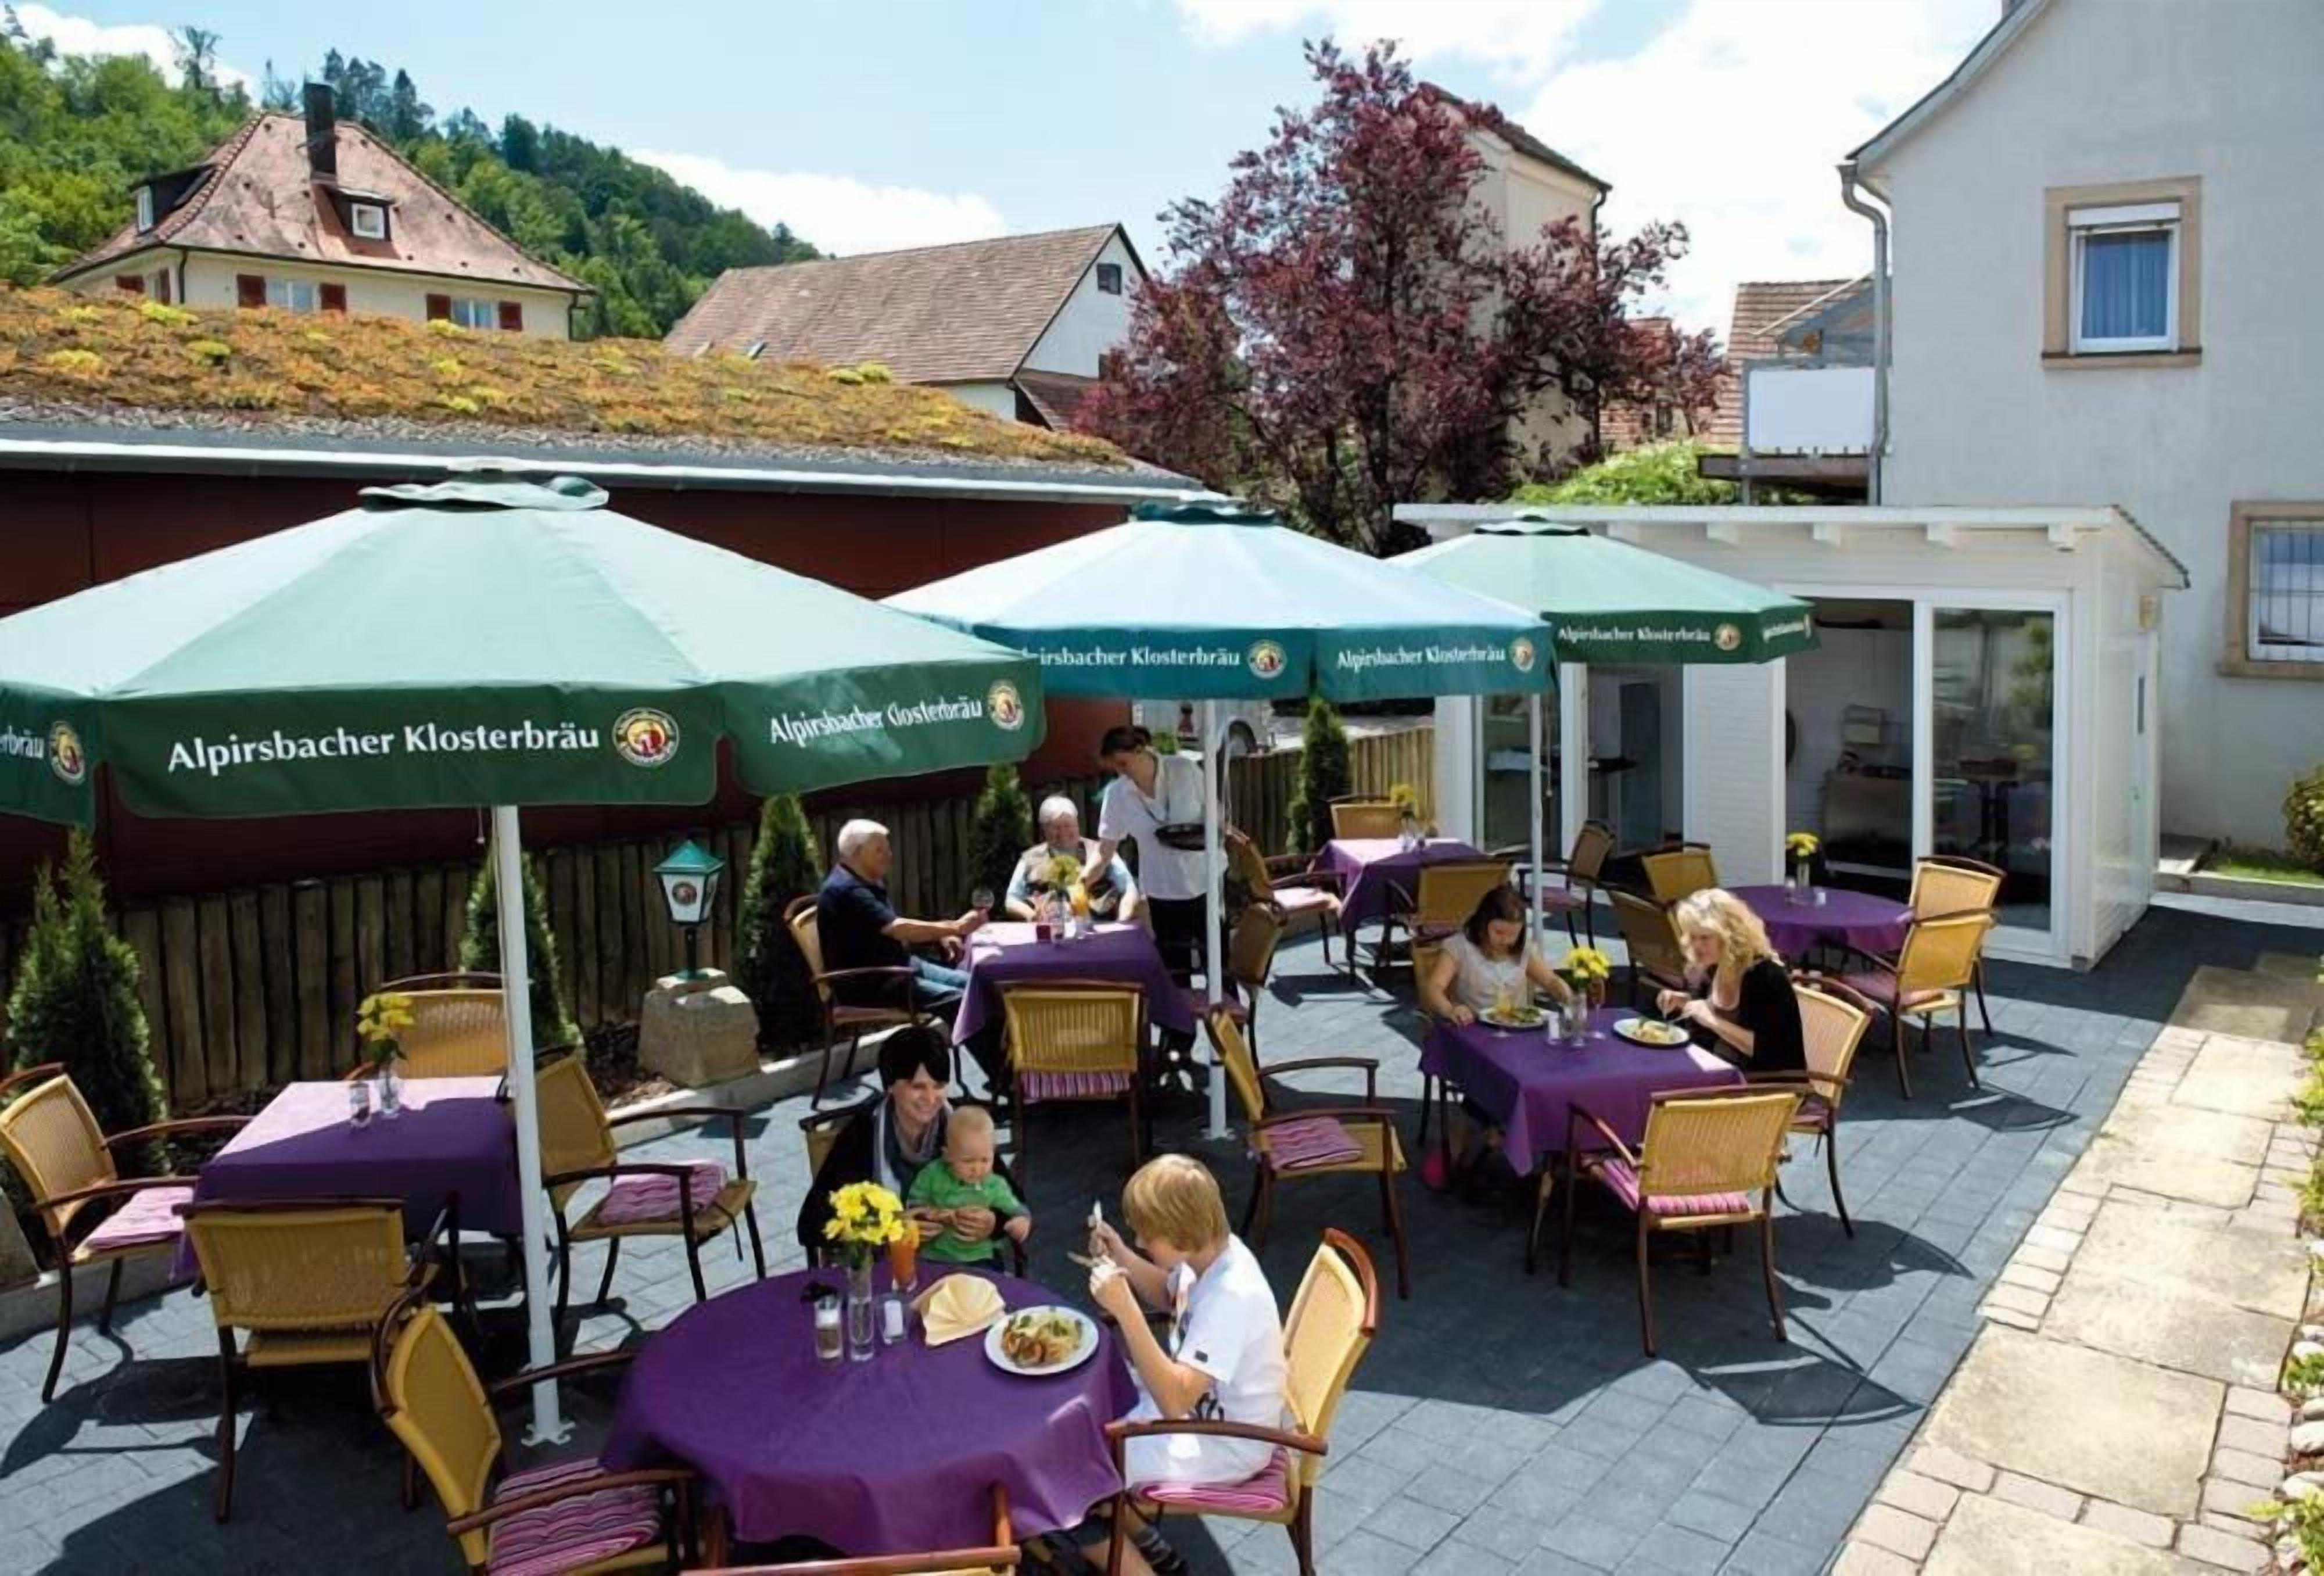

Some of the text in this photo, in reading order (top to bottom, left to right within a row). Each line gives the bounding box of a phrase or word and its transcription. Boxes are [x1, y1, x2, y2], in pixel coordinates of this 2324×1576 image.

[1039, 646, 1240, 666] irsbacher Klosterbräu
[167, 726, 395, 776] Alpirsbacher
[404, 719, 600, 753] Klosterbräu
